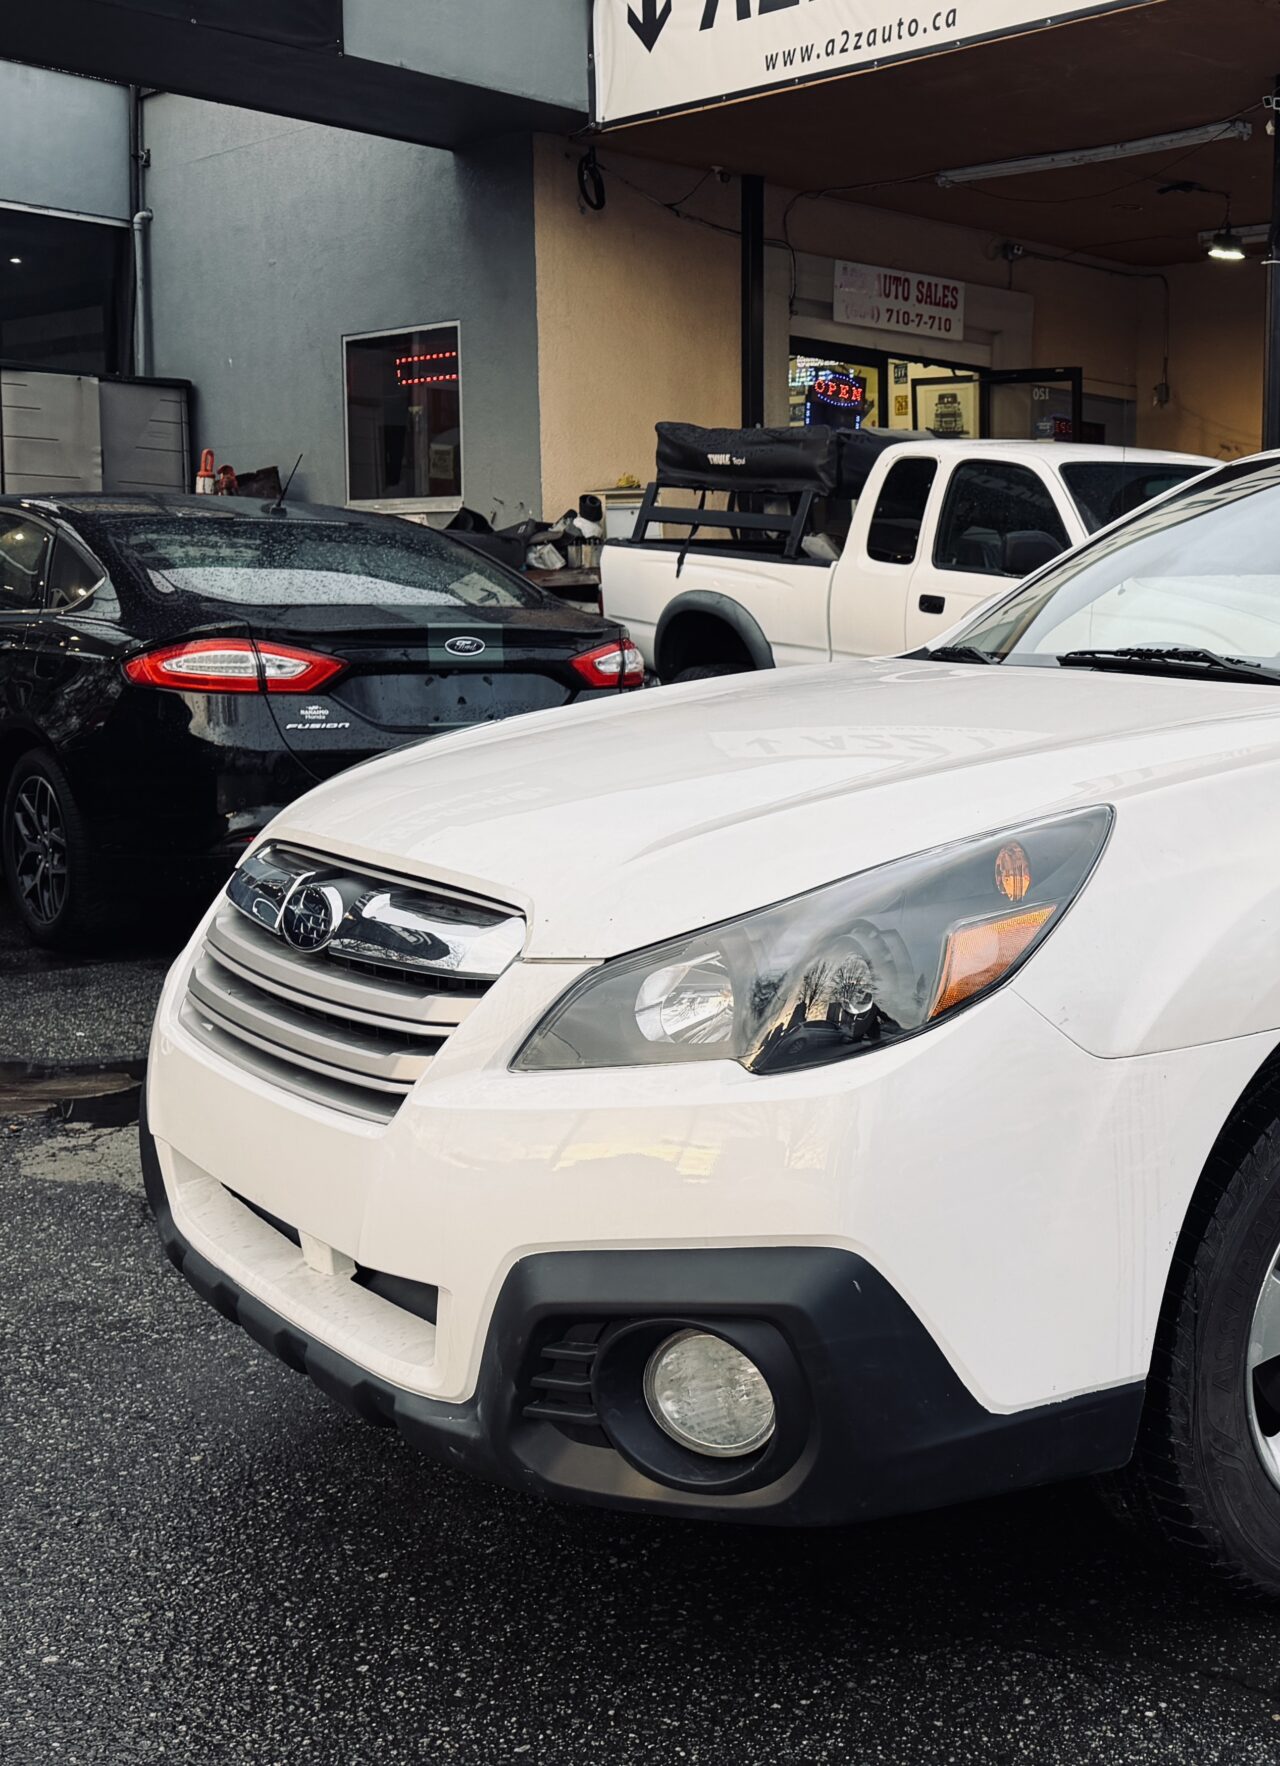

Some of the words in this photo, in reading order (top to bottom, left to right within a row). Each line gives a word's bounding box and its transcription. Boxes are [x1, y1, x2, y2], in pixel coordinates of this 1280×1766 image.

[764, 8, 958, 72] www.a2zauto.ca
[916, 279, 959, 310] SALES
[885, 308, 952, 333] 710-7-710
[814, 379, 864, 401] OPEN
[707, 453, 731, 466] THULE
[285, 722, 351, 730] FUSION
